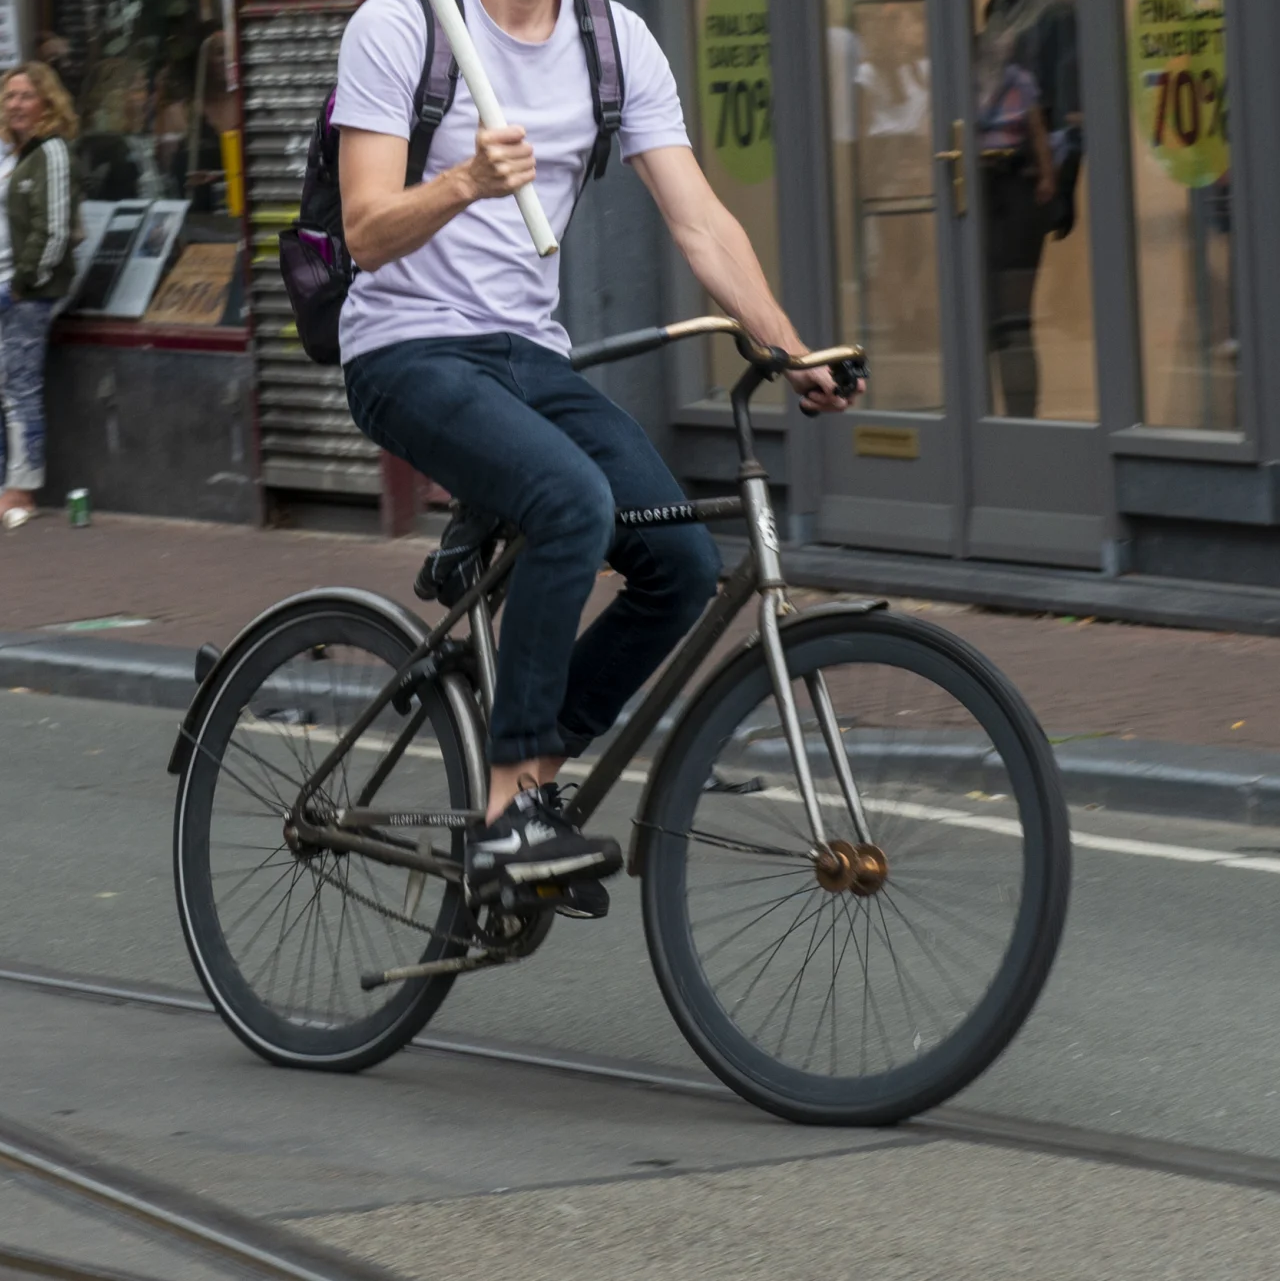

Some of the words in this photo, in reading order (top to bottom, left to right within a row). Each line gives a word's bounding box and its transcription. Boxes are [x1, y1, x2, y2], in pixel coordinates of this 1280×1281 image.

[1139, 30, 1183, 59] SAVE
[620, 505, 694, 525] VELORETTI
[389, 813, 424, 827] VELORETTI
[428, 813, 466, 827] AMSTERDAM
